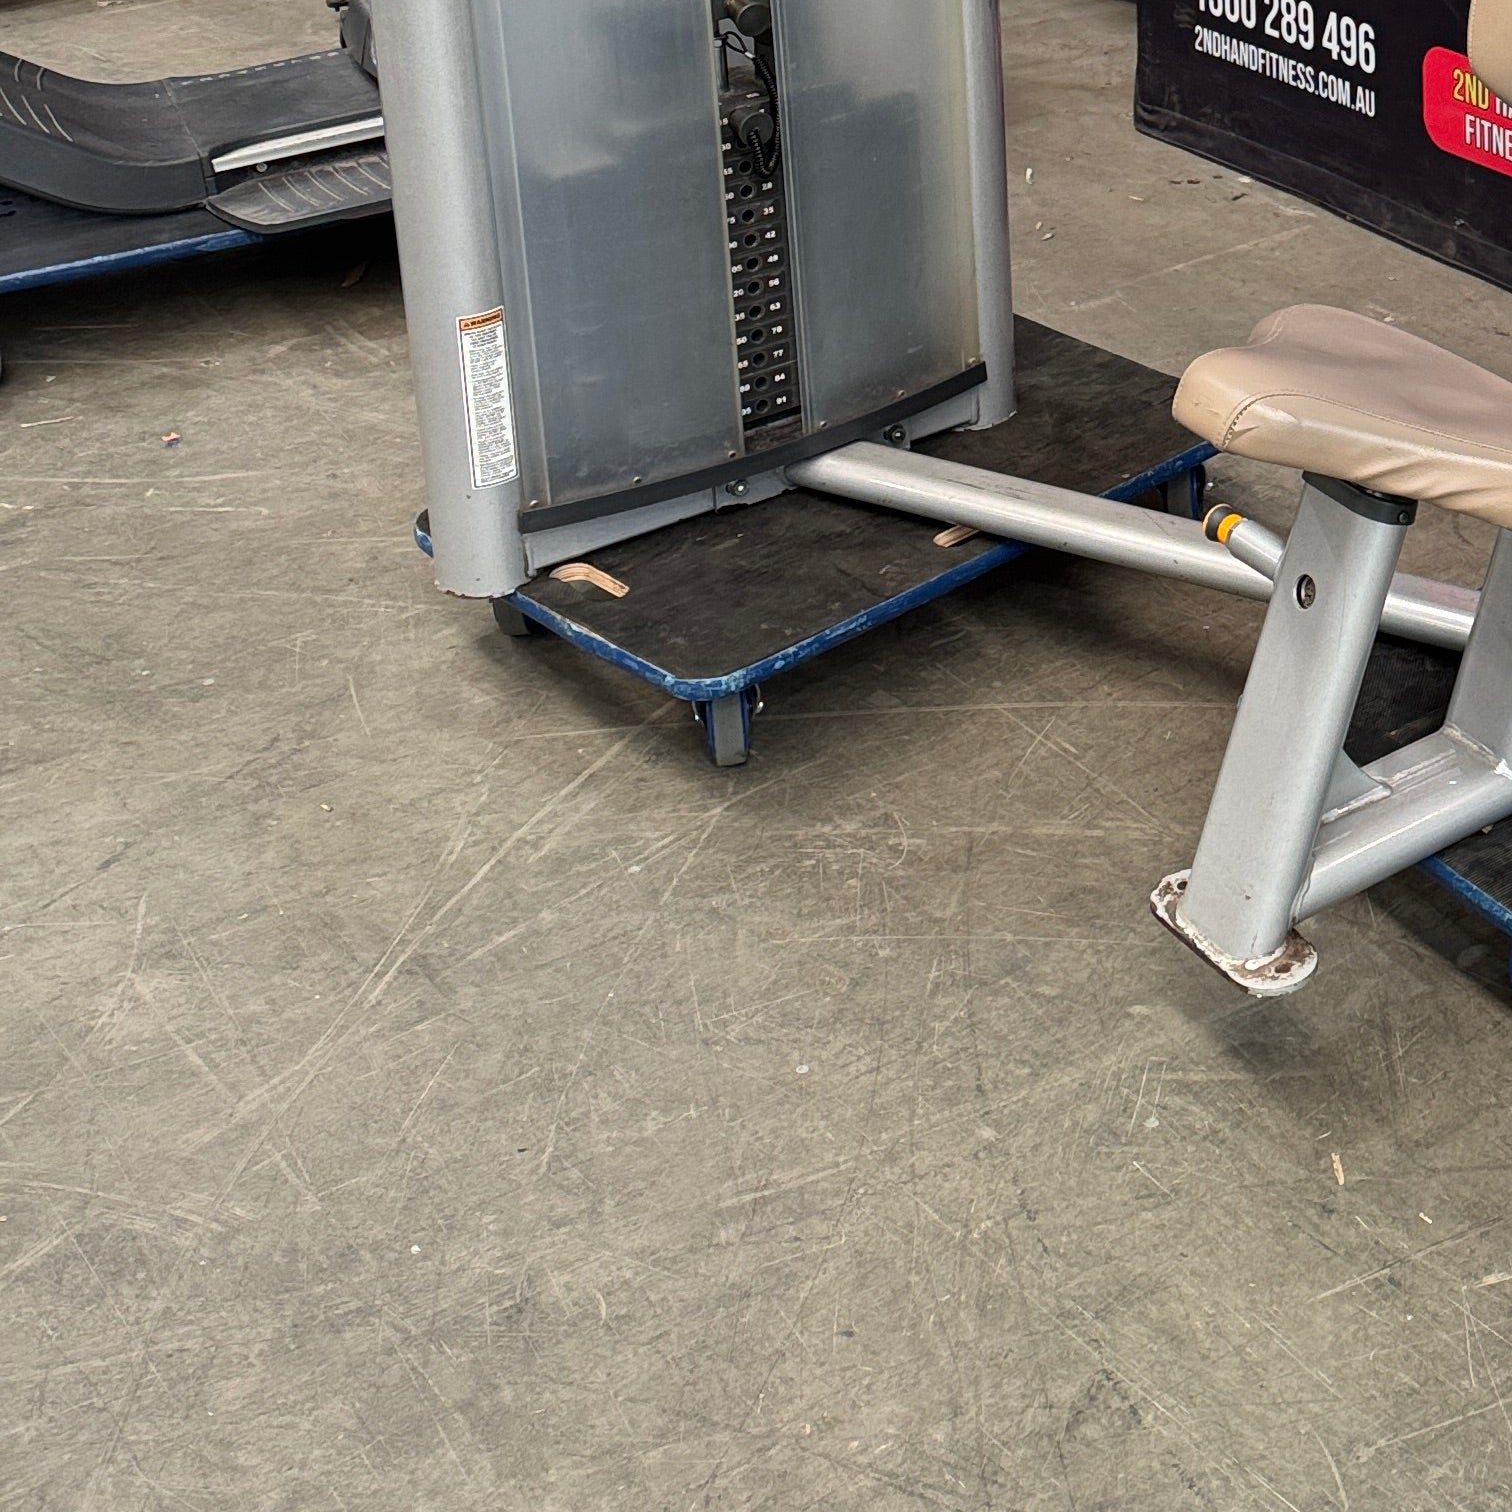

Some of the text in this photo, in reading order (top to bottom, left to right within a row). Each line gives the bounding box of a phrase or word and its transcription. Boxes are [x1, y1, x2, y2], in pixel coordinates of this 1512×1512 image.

[1194, 25, 1376, 118] 2NDHANDFITNESS.COM.AU
[1322, 10, 1376, 74] 496
[1453, 68, 1489, 110] 2ND
